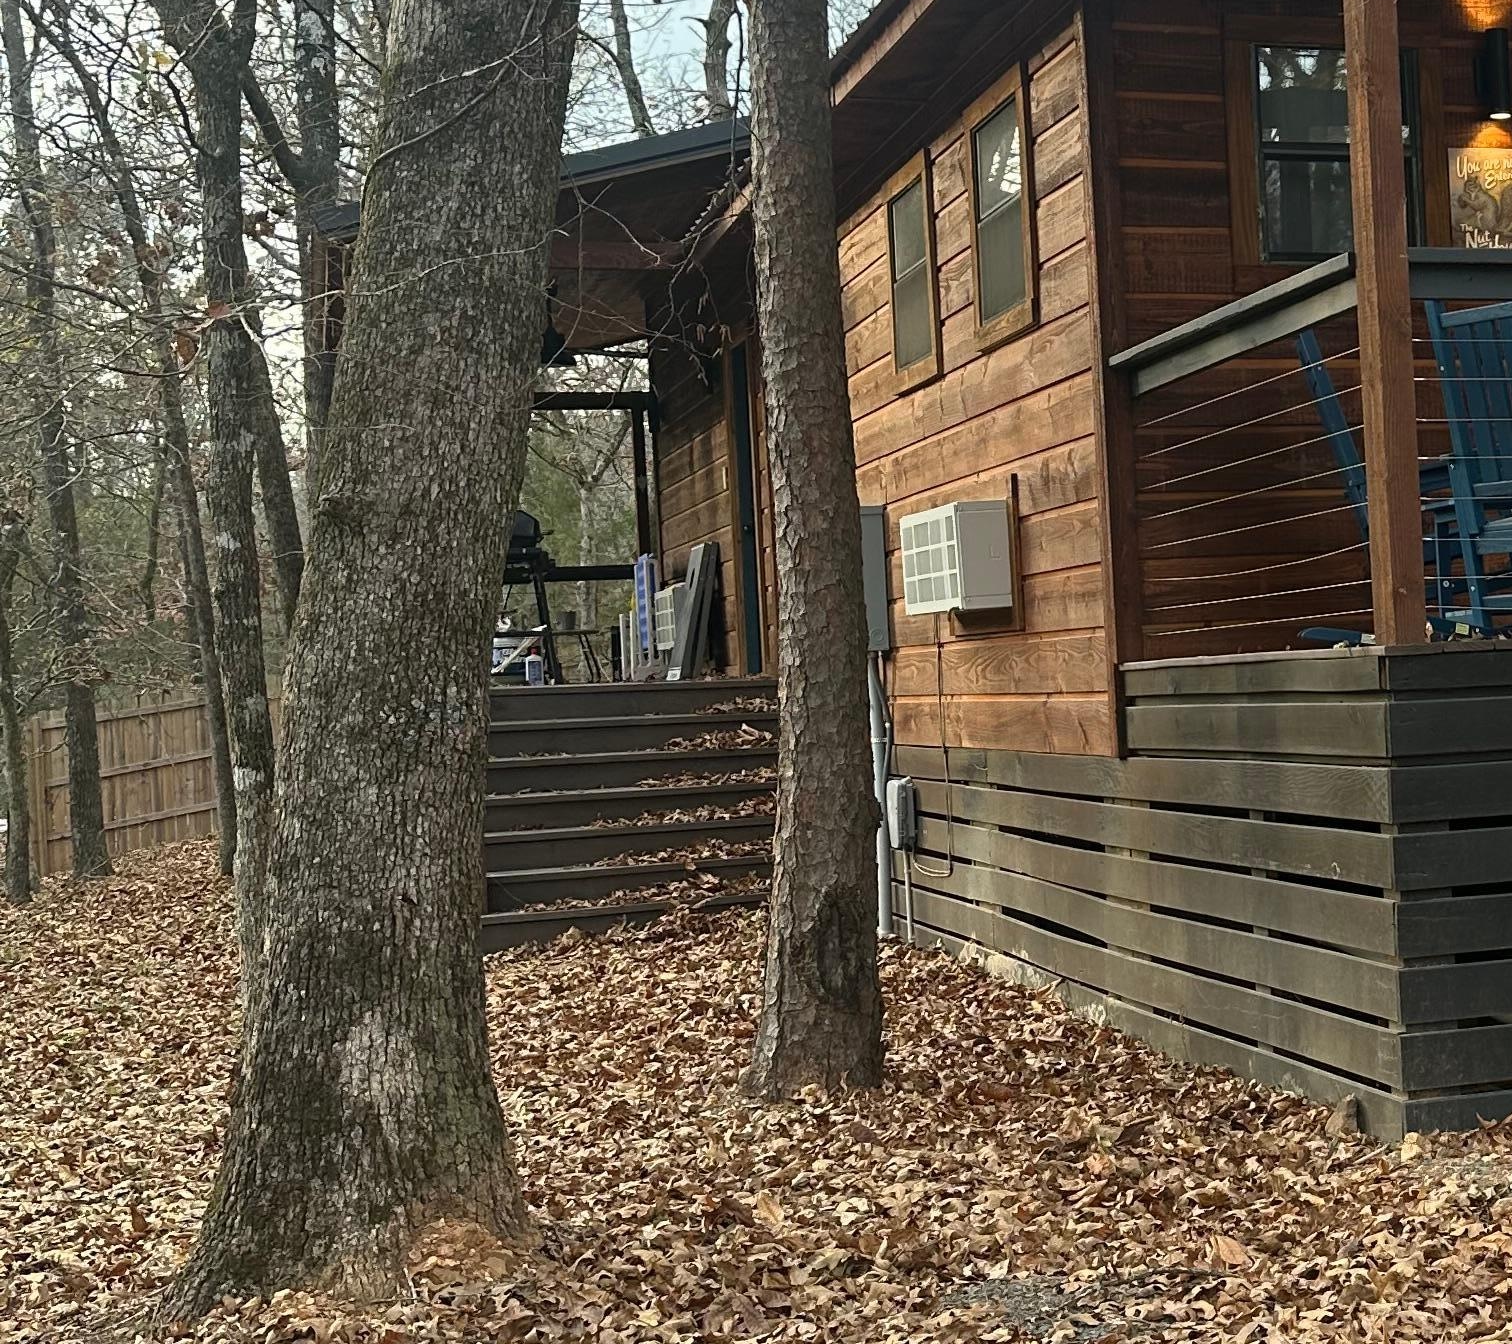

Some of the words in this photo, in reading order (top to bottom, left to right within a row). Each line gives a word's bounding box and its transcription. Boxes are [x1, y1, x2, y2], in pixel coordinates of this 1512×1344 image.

[1456, 156, 1481, 180] You
[1483, 159, 1501, 170] are
[1460, 223, 1474, 232] The
[1465, 228, 1491, 249] Nut
